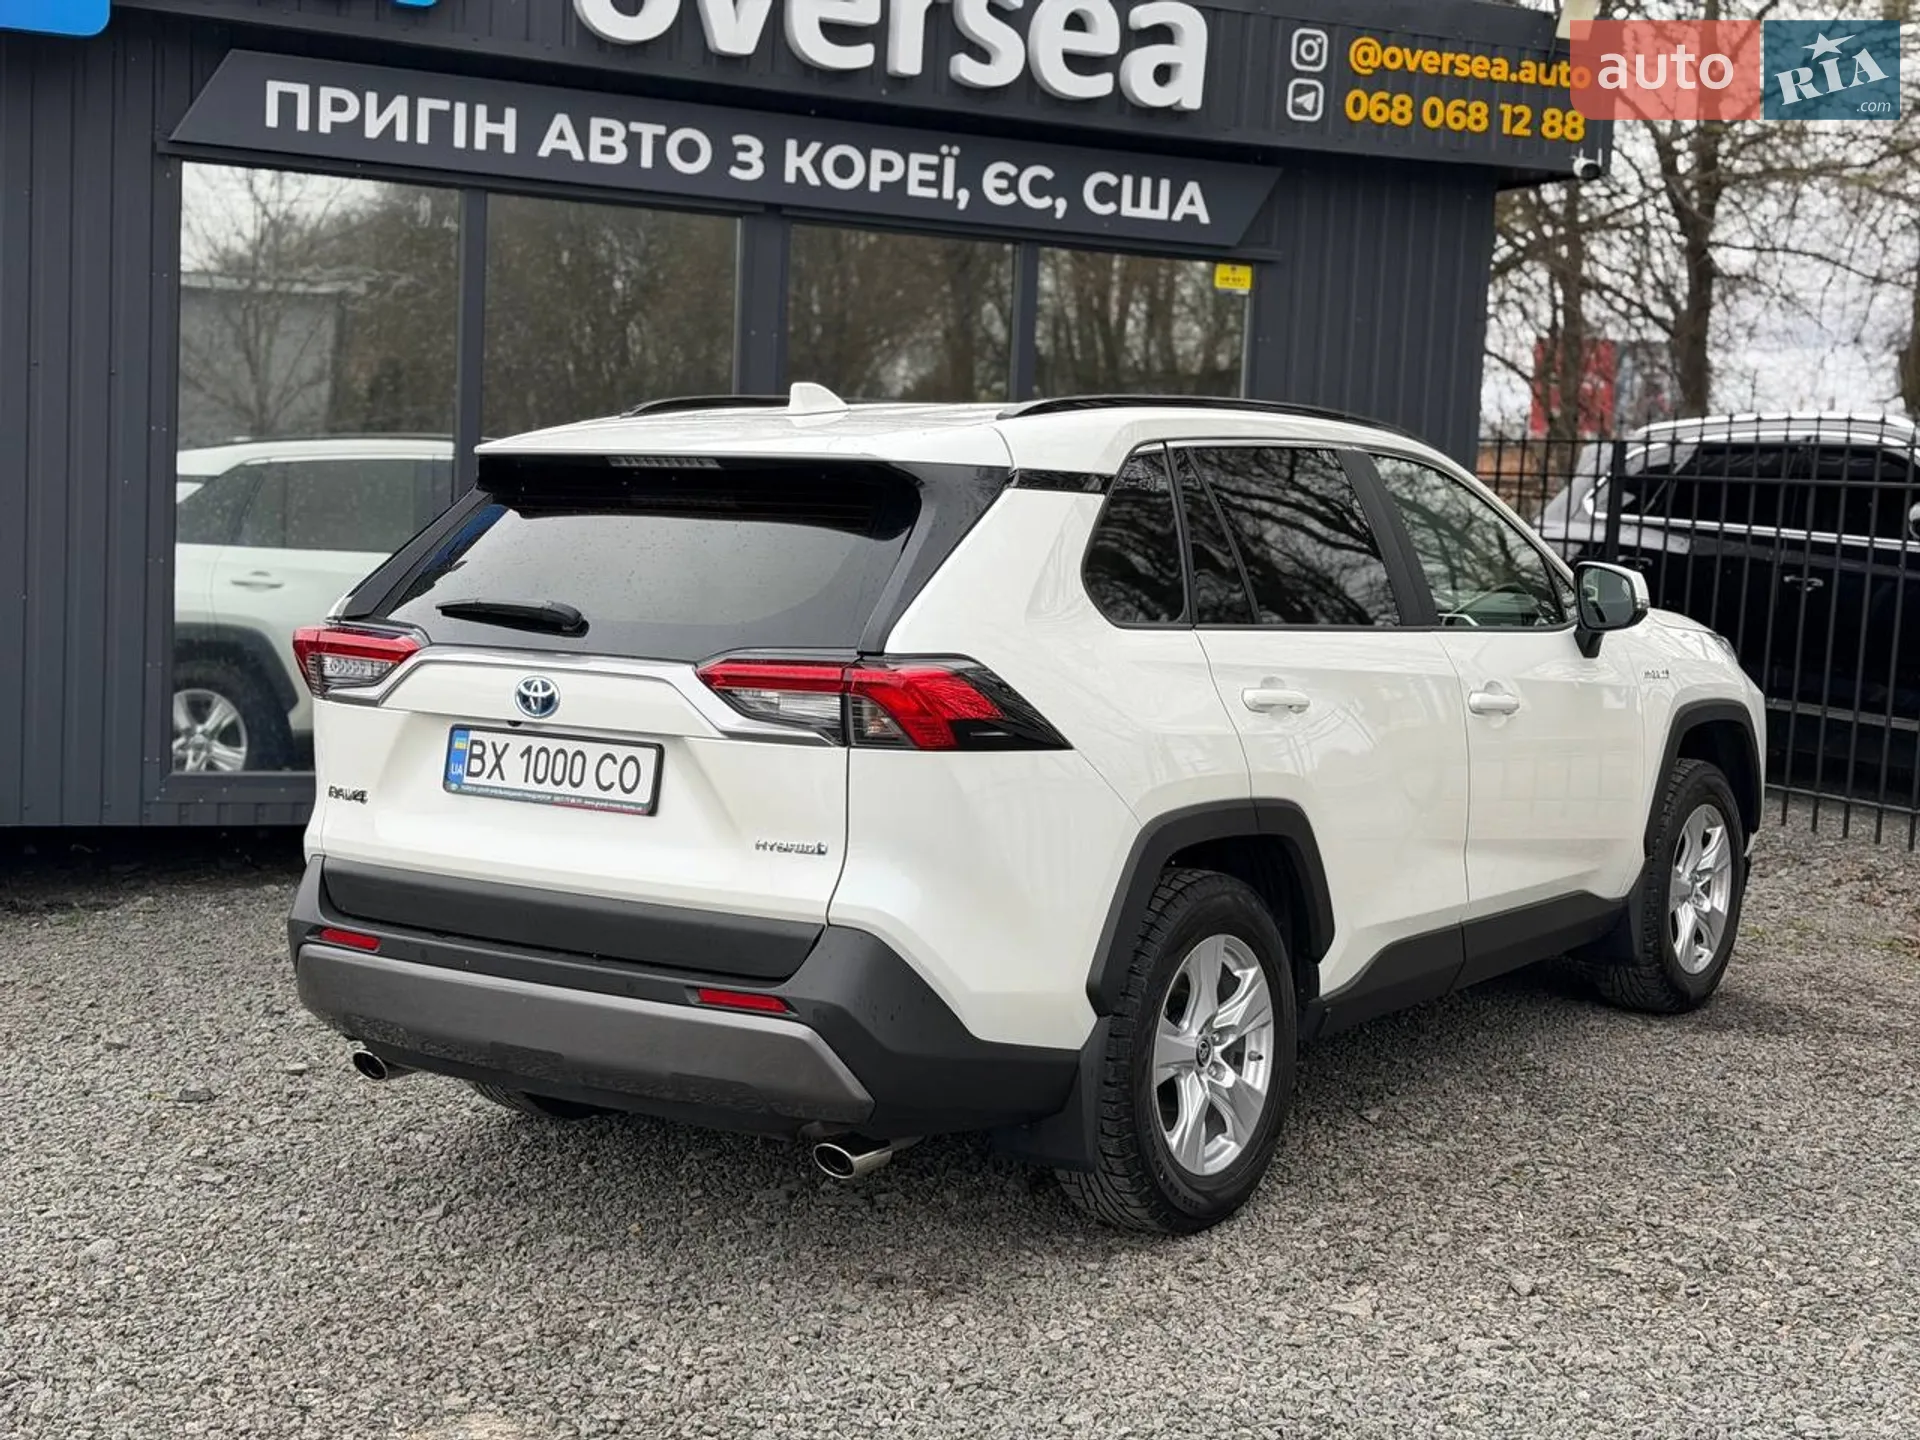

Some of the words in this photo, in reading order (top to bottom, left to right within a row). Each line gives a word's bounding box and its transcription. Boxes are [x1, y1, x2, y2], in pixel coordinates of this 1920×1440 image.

[1349, 36, 1592, 88] @oversea.auto
[1345, 89, 1414, 126] 068
[1421, 96, 1489, 132] 068
[1499, 103, 1532, 137] 12
[1541, 108, 1586, 141] 88
[265, 80, 517, 154] ПРИГІН
[537, 113, 713, 175] АВТО
[728, 134, 765, 181] З
[784, 139, 970, 210] КОРЕЇ,
[982, 161, 1068, 219] ЄС,
[1082, 171, 1210, 224] США
[451, 763, 464, 776] UA
[465, 739, 510, 781] BX
[519, 744, 587, 788] 1000
[595, 752, 642, 795] CO
